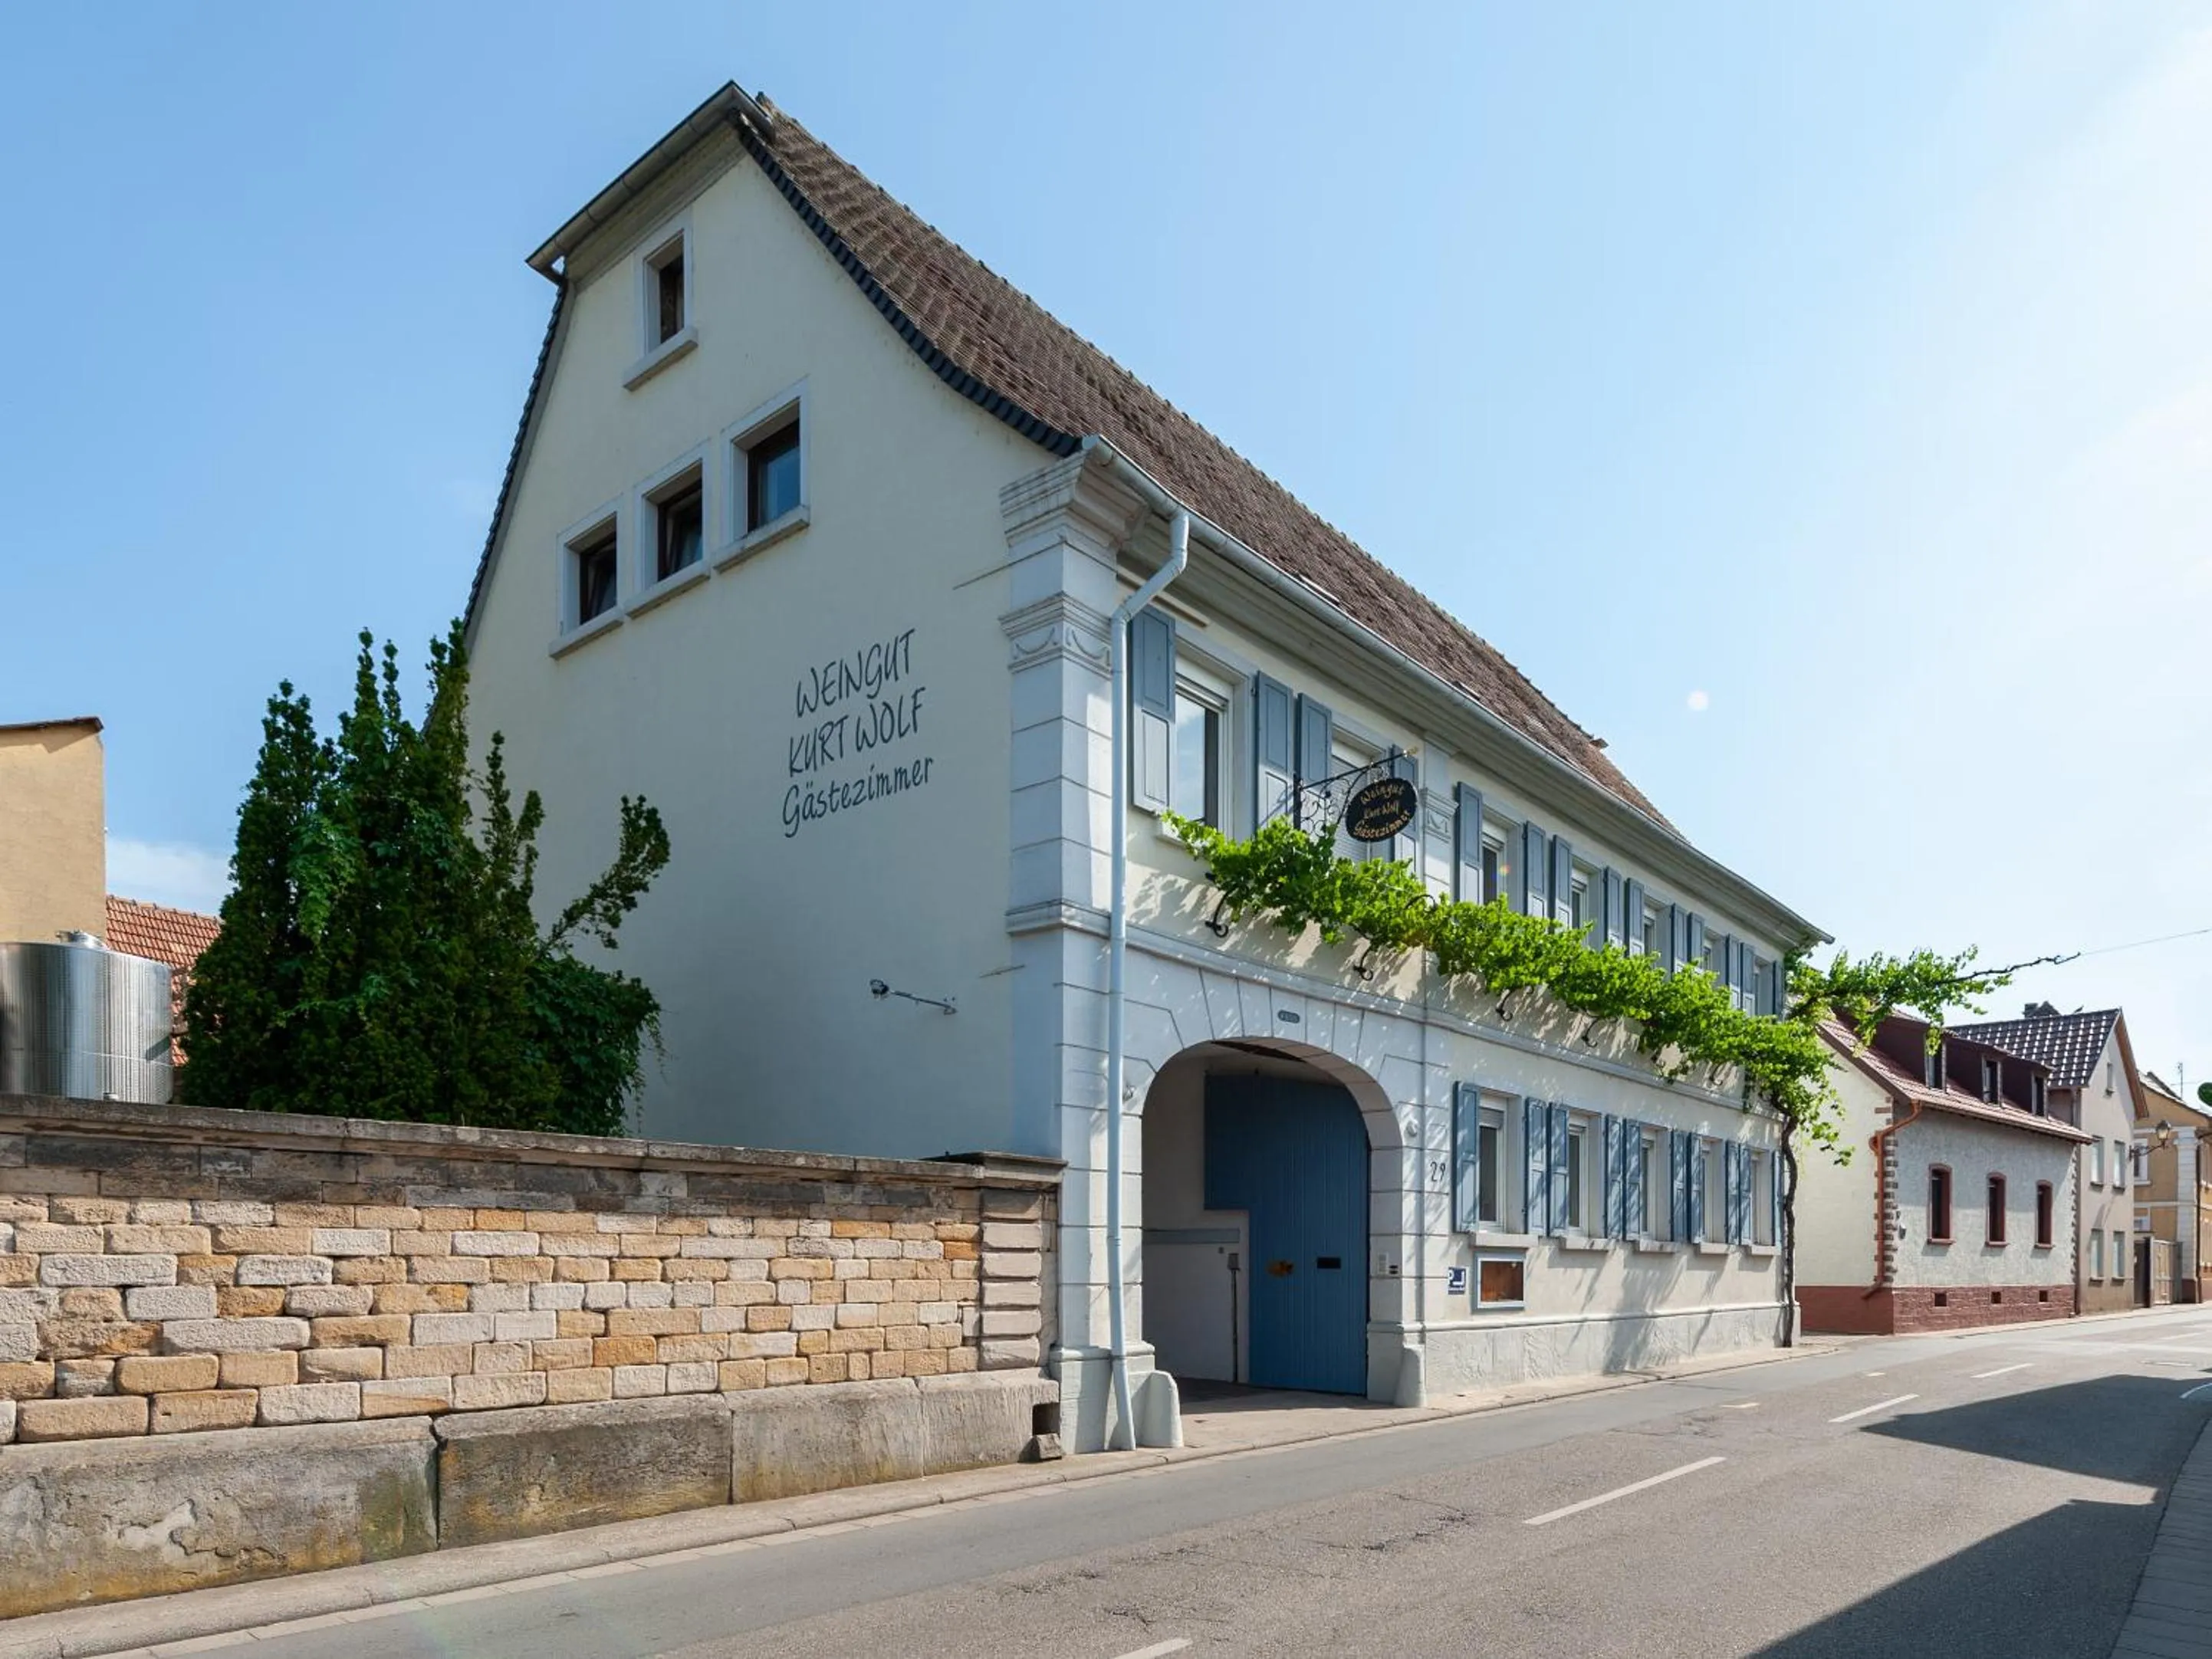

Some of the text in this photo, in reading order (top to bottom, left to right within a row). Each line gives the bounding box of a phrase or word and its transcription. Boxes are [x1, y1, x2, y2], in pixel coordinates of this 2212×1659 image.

[796, 627, 915, 718] WEINGUT
[789, 687, 925, 777] KURT WOLF
[782, 757, 933, 838] Gästezimmer
[1360, 784, 1405, 804] Weingut
[1430, 1161, 1445, 1181] 29
